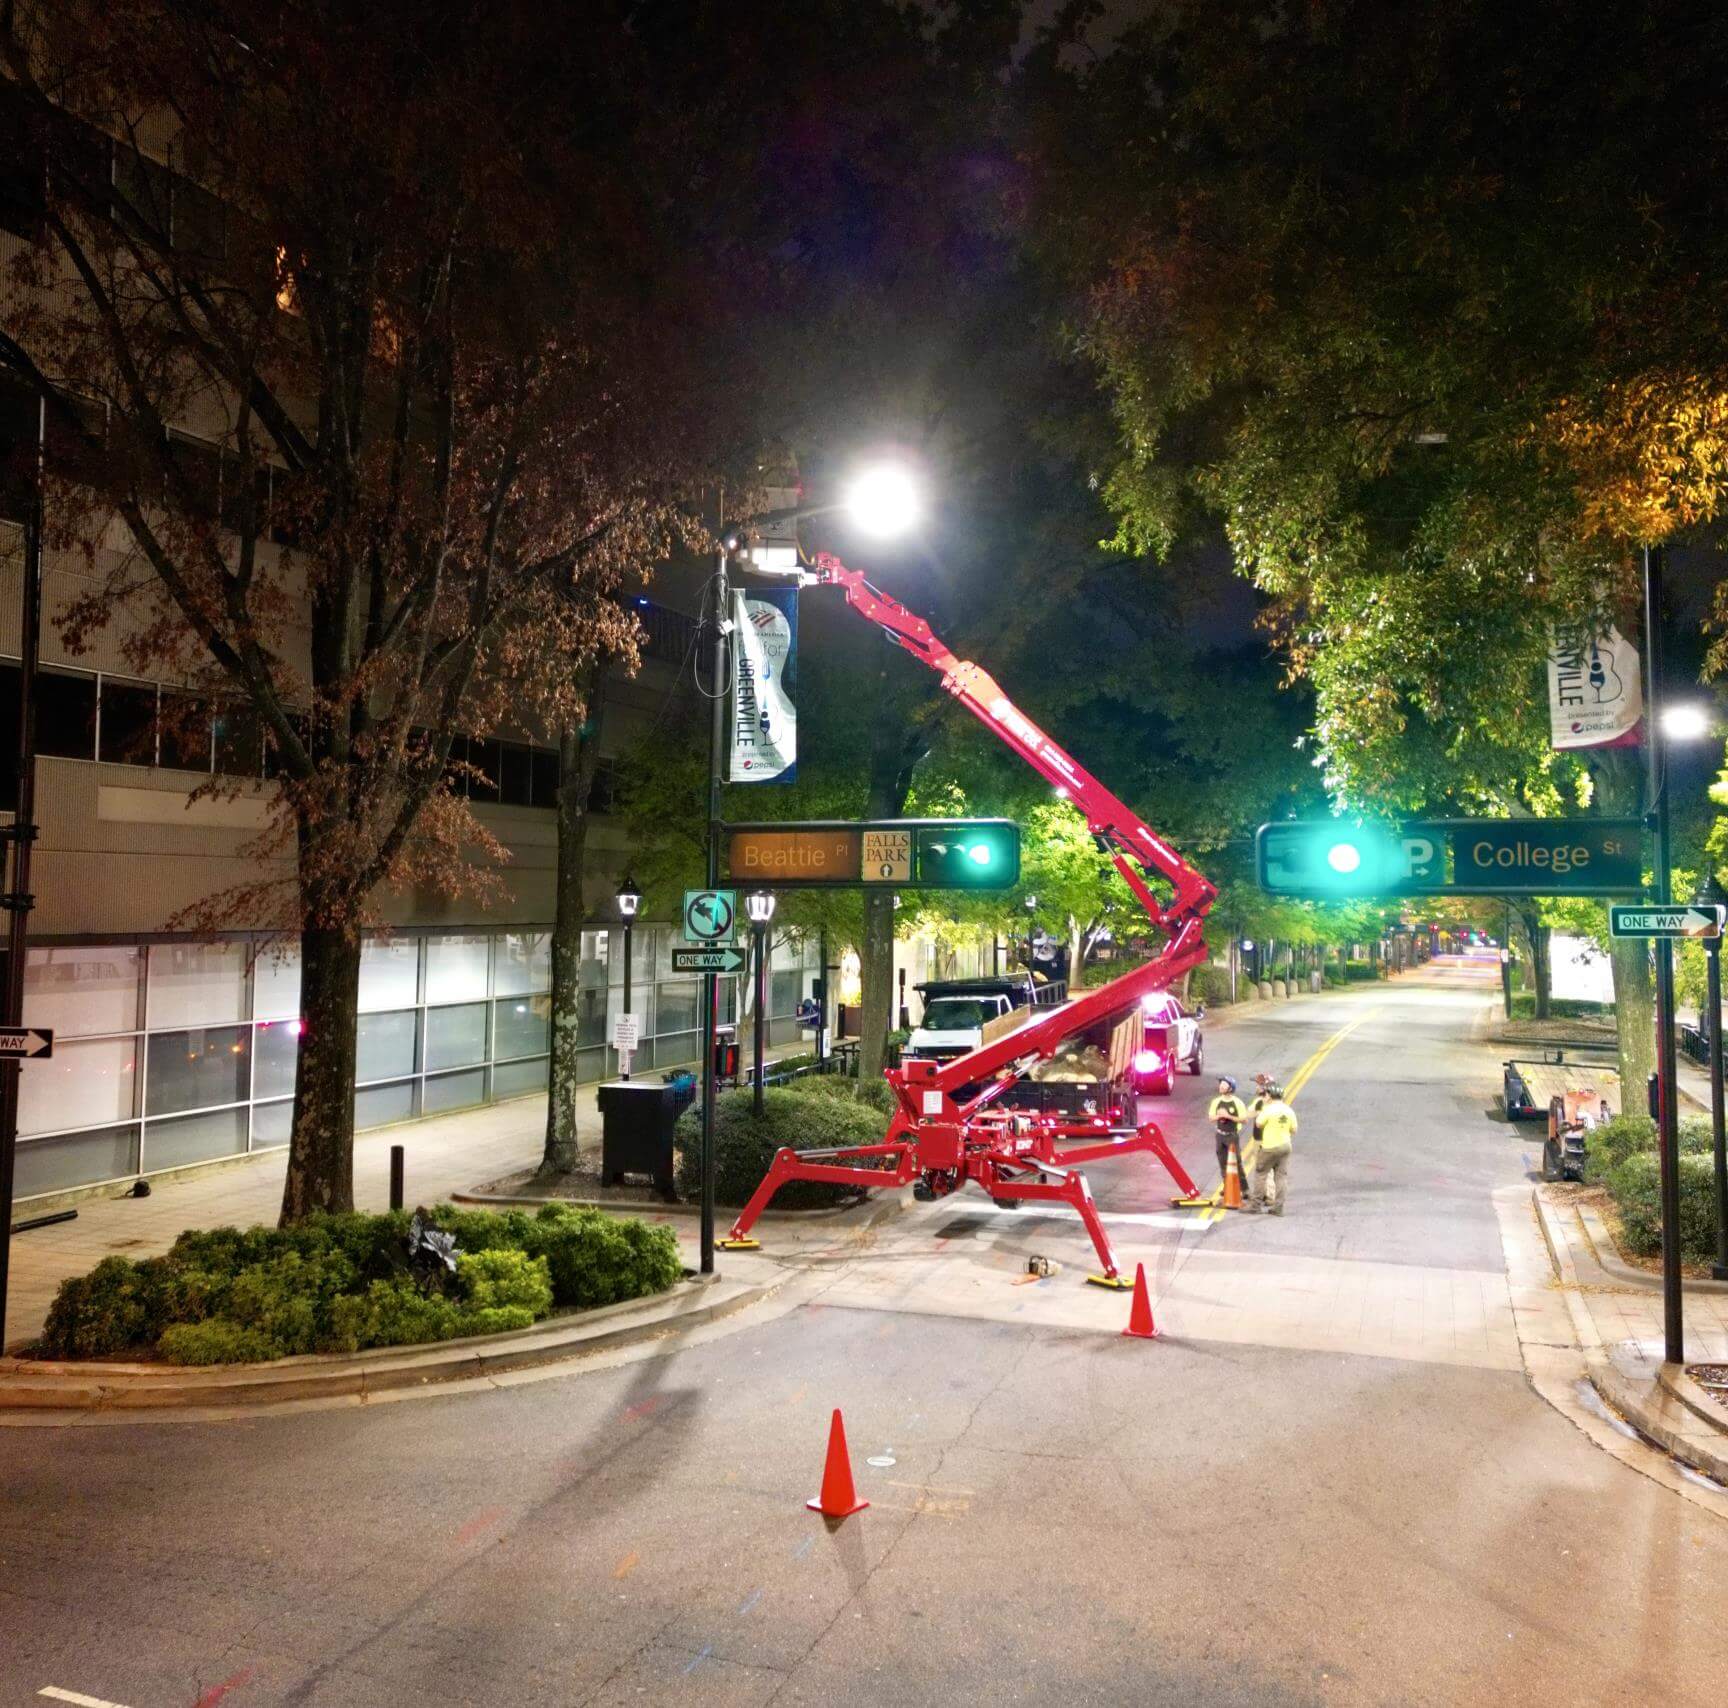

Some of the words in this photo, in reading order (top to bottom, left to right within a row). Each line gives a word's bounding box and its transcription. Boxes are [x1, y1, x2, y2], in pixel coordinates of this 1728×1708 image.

[736, 658, 755, 747] GREENVILLE
[1585, 721, 1615, 732] pepsi
[867, 834, 909, 848] FALLS
[744, 845, 826, 867] Beattie
[836, 844, 848, 856] Pl
[866, 848, 907, 862] PARK
[1401, 838, 1434, 878] P
[1472, 841, 1590, 873] College
[1602, 840, 1623, 856] St
[1622, 916, 1650, 928] ONE
[1656, 916, 1685, 928] WAY
[679, 955, 699, 966] ONE
[702, 955, 724, 966] WAY
[0, 1036, 26, 1049] WAY
